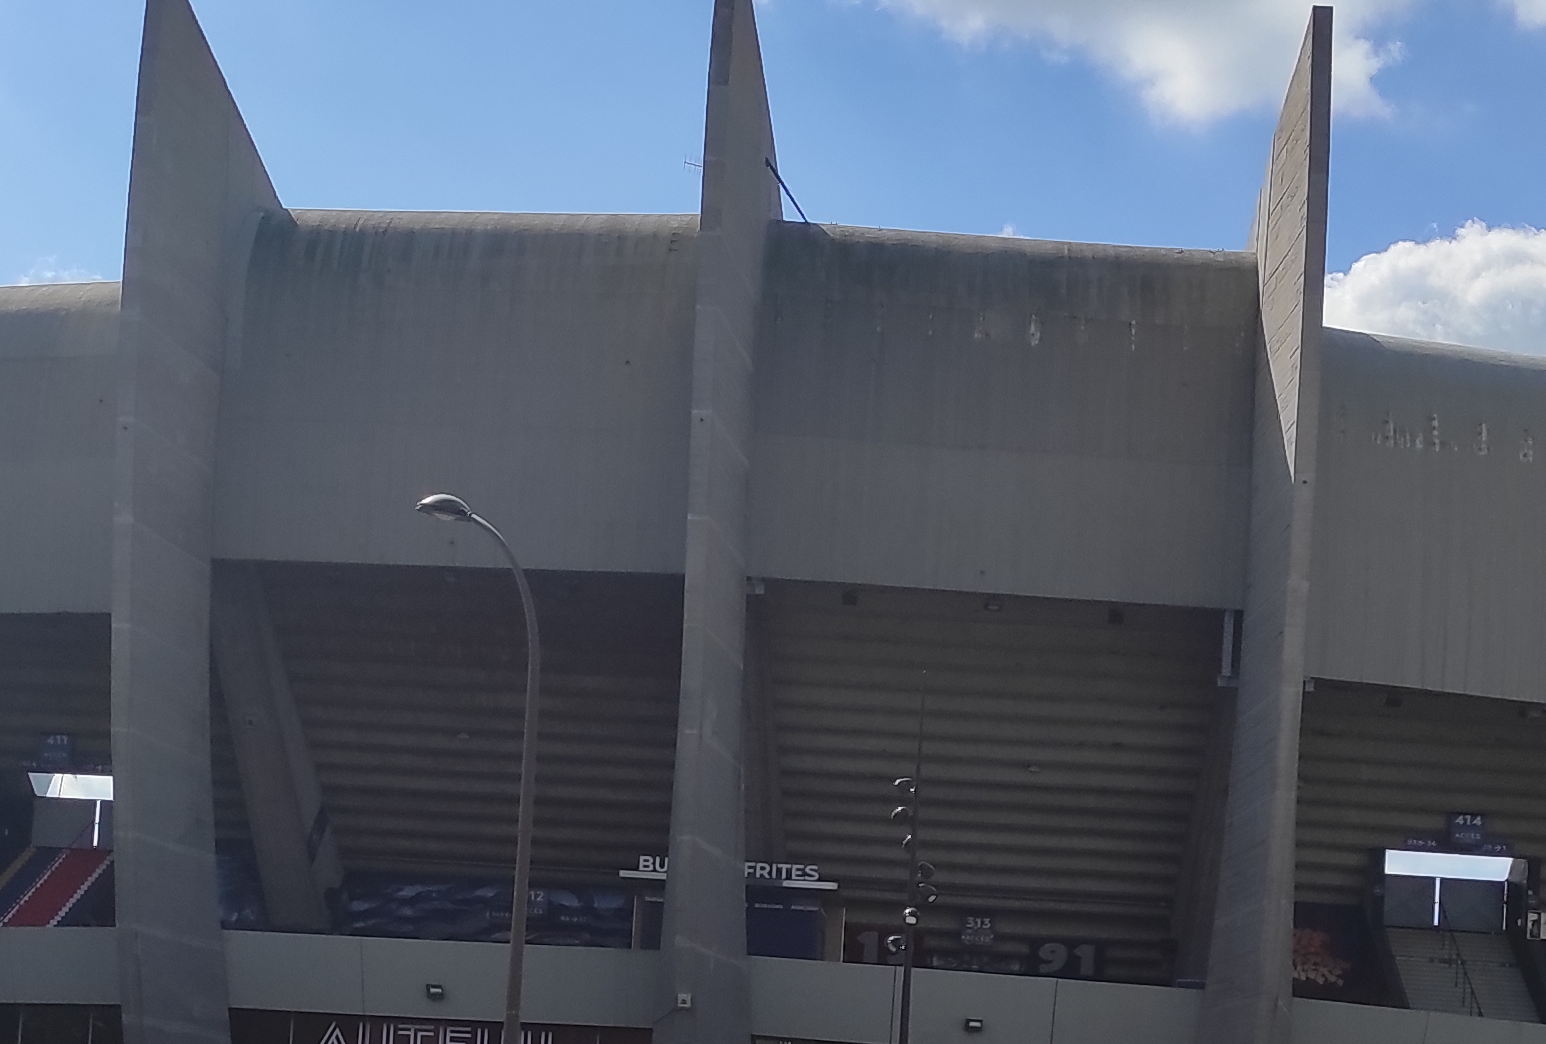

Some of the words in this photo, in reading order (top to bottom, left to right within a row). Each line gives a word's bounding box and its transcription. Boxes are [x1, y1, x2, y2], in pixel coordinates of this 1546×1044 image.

[1454, 815, 1482, 827] 414
[744, 861, 820, 881] FRITES
[965, 916, 992, 929] 313
[1038, 942, 1096, 976] 91
